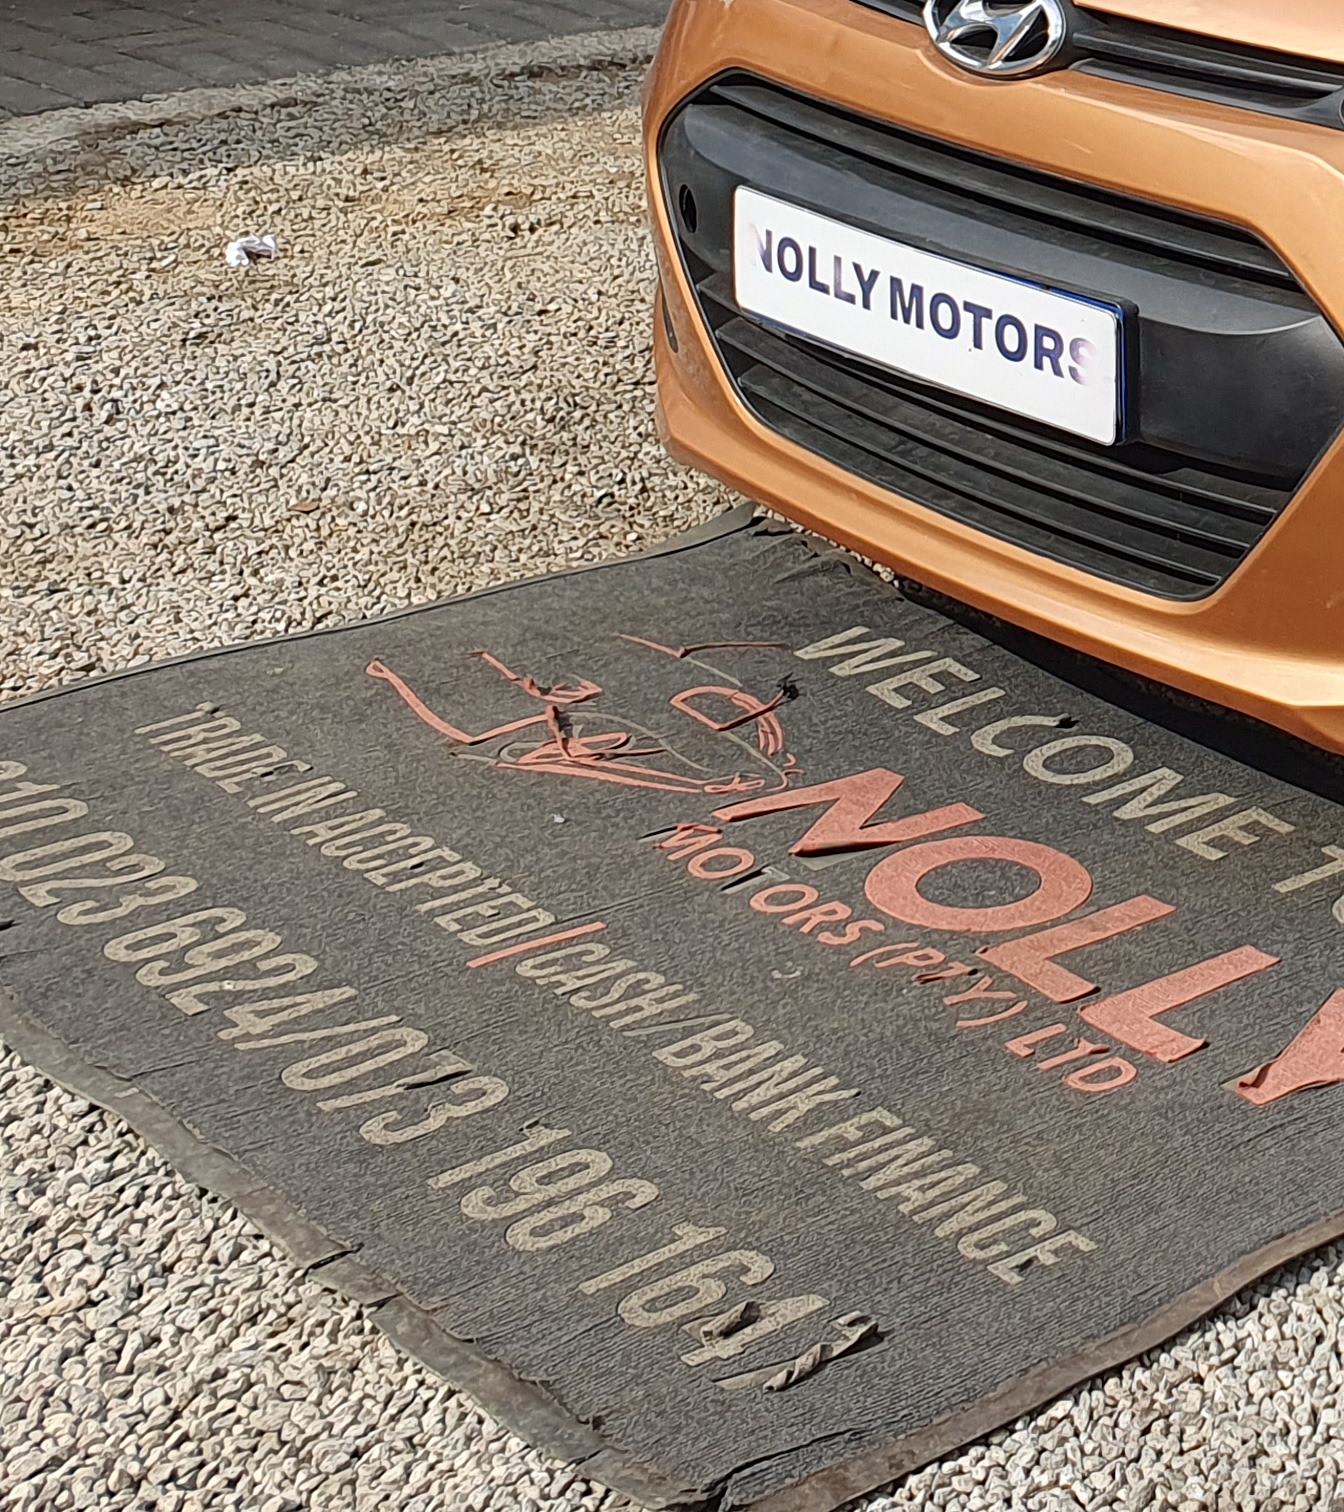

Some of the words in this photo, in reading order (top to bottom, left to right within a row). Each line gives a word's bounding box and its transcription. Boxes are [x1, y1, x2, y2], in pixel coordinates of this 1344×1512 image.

[750, 223, 880, 311] NOLLY
[889, 275, 1096, 386] MOTORS
[794, 626, 1295, 861] WELCOME
[0, 831, 199, 925] 023
[427, 1120, 660, 1252] 196
[134, 701, 311, 794] TRADE
[247, 775, 357, 824] IN
[797, 1105, 1098, 1286] FINANCE
[1005, 1024, 1138, 1092] LTD
